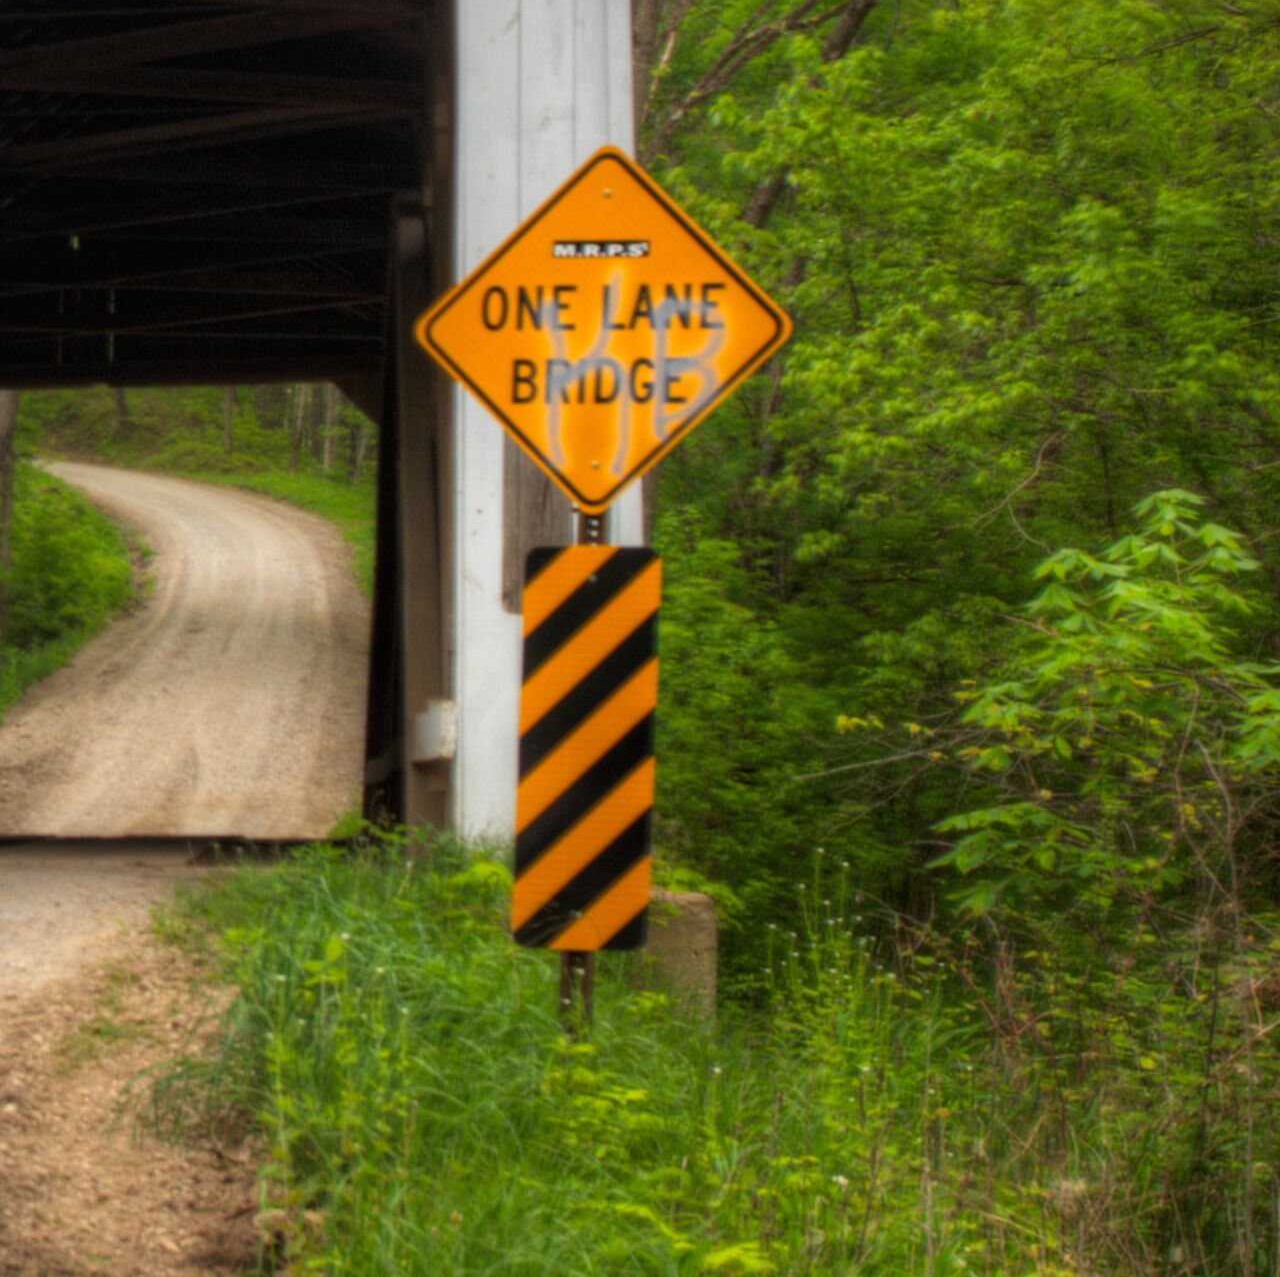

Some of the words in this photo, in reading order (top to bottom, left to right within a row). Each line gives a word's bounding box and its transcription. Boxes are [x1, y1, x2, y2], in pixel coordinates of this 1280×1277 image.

[481, 284, 577, 331] ONE
[601, 282, 727, 330] LANE
[511, 357, 687, 405] BRIDGE
